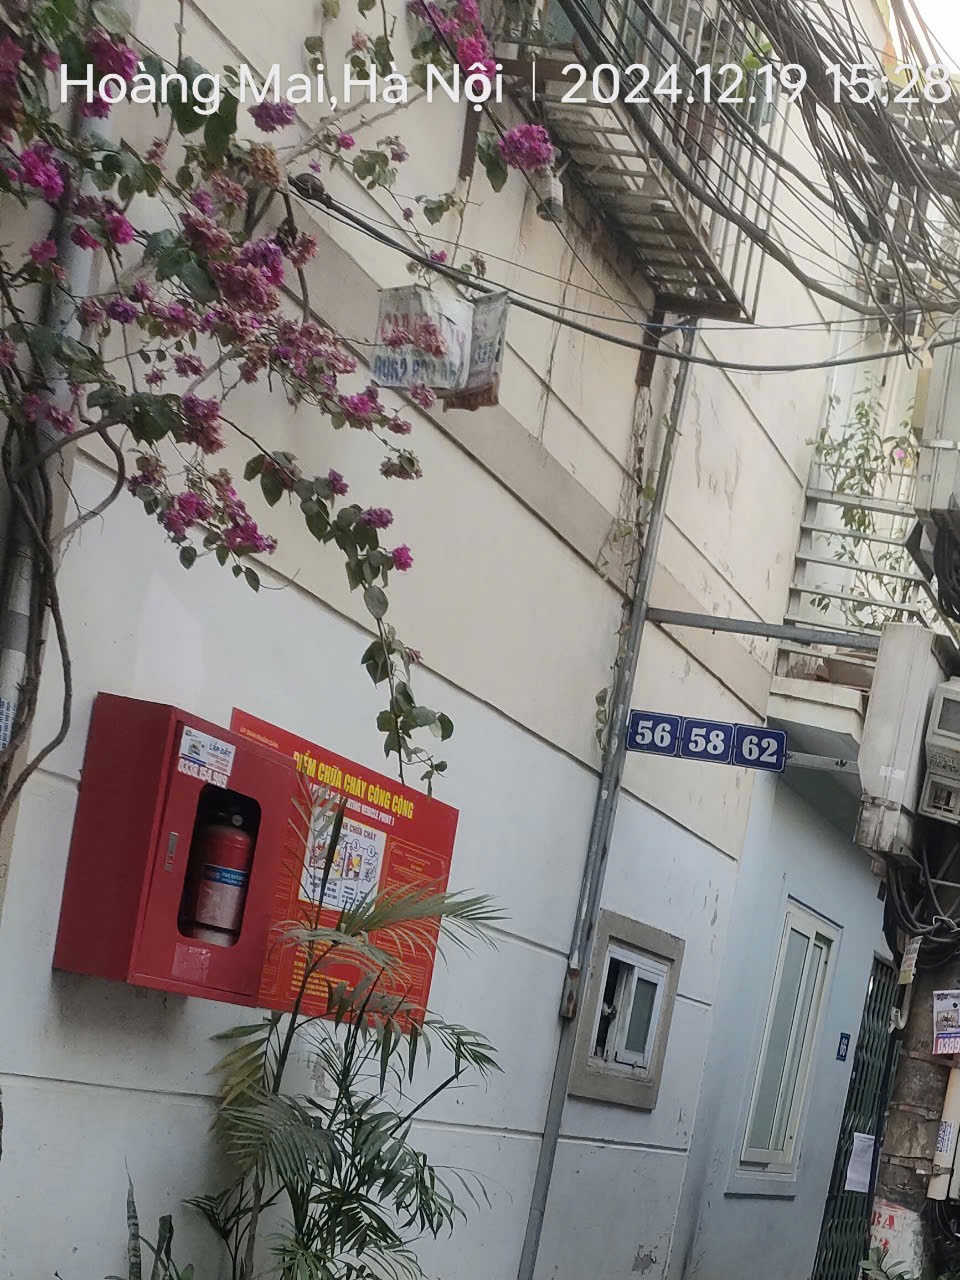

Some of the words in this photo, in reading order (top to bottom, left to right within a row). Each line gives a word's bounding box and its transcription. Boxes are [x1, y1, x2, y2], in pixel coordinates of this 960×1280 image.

[635, 720, 671, 747] 56
[689, 728, 725, 755] 58
[742, 736, 778, 764] 62
[391, 794, 414, 819] CỘNG
